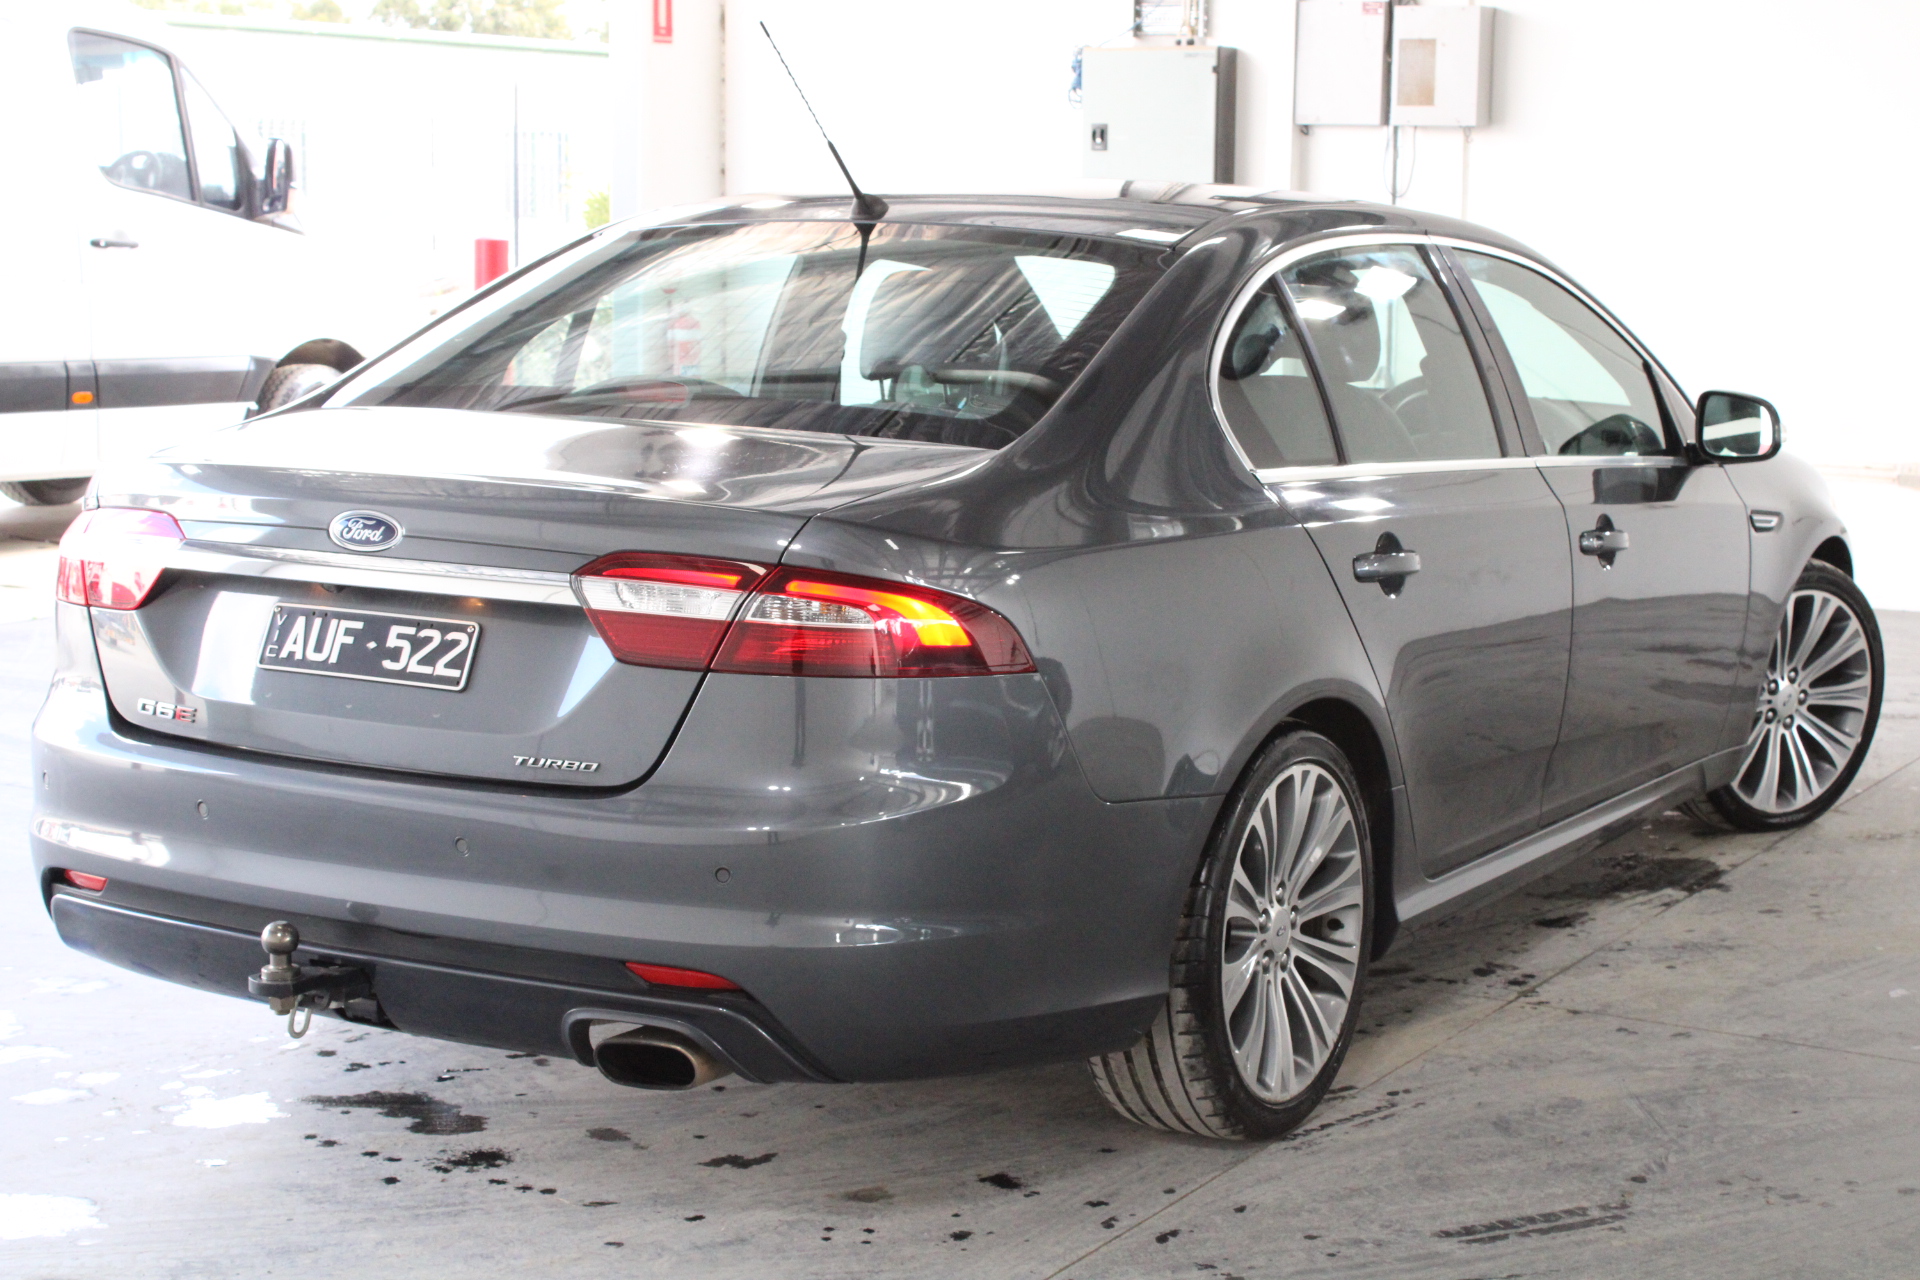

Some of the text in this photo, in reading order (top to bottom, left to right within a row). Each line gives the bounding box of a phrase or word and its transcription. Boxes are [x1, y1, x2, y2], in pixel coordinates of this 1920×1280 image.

[342, 517, 386, 542] Ford
[266, 614, 287, 657] VIC
[137, 698, 197, 723] G6E
[513, 755, 599, 772] TURBO
